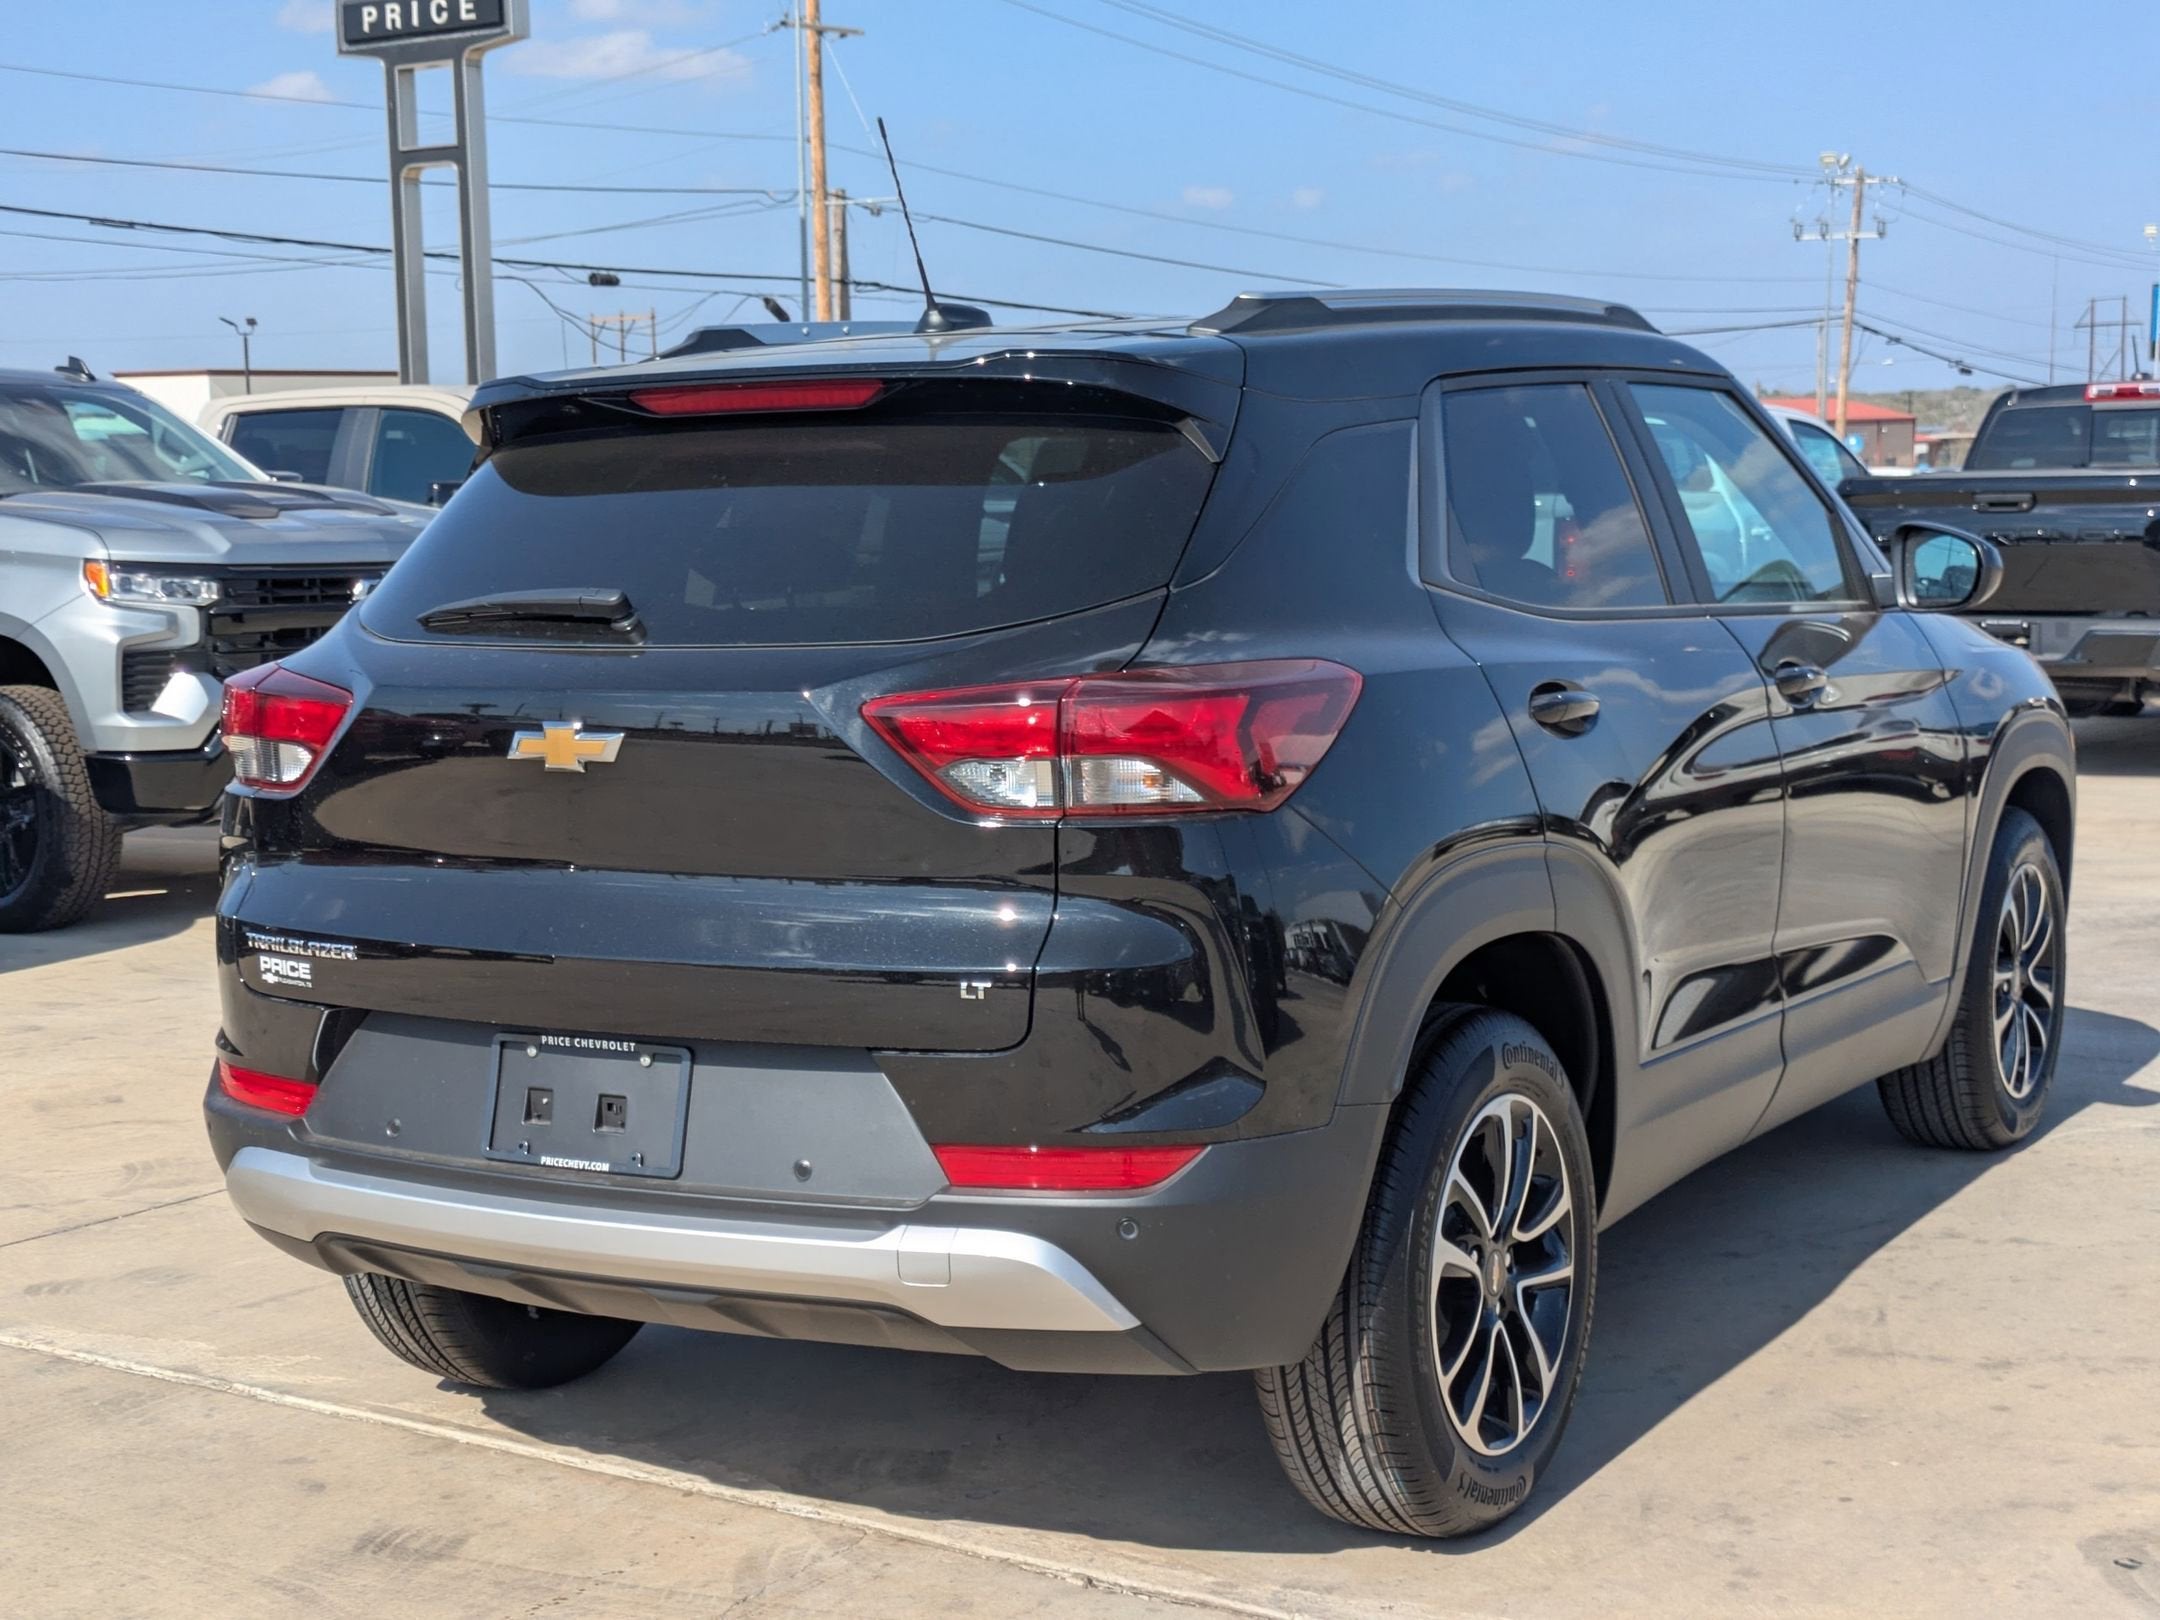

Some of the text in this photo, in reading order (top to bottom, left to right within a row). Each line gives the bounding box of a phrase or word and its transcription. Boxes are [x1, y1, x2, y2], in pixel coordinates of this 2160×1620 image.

[361, 0, 477, 33] PRICE
[245, 932, 357, 960] TRAILBLAZER
[259, 956, 312, 980] PRICE
[960, 982, 992, 999] LT
[541, 1035, 636, 1052] PRICE CHEVROLET
[1502, 1040, 1558, 1083] Continental
[540, 1156, 610, 1172] PRICECHEVY.COM
[1464, 1475, 1526, 1511] Continental
